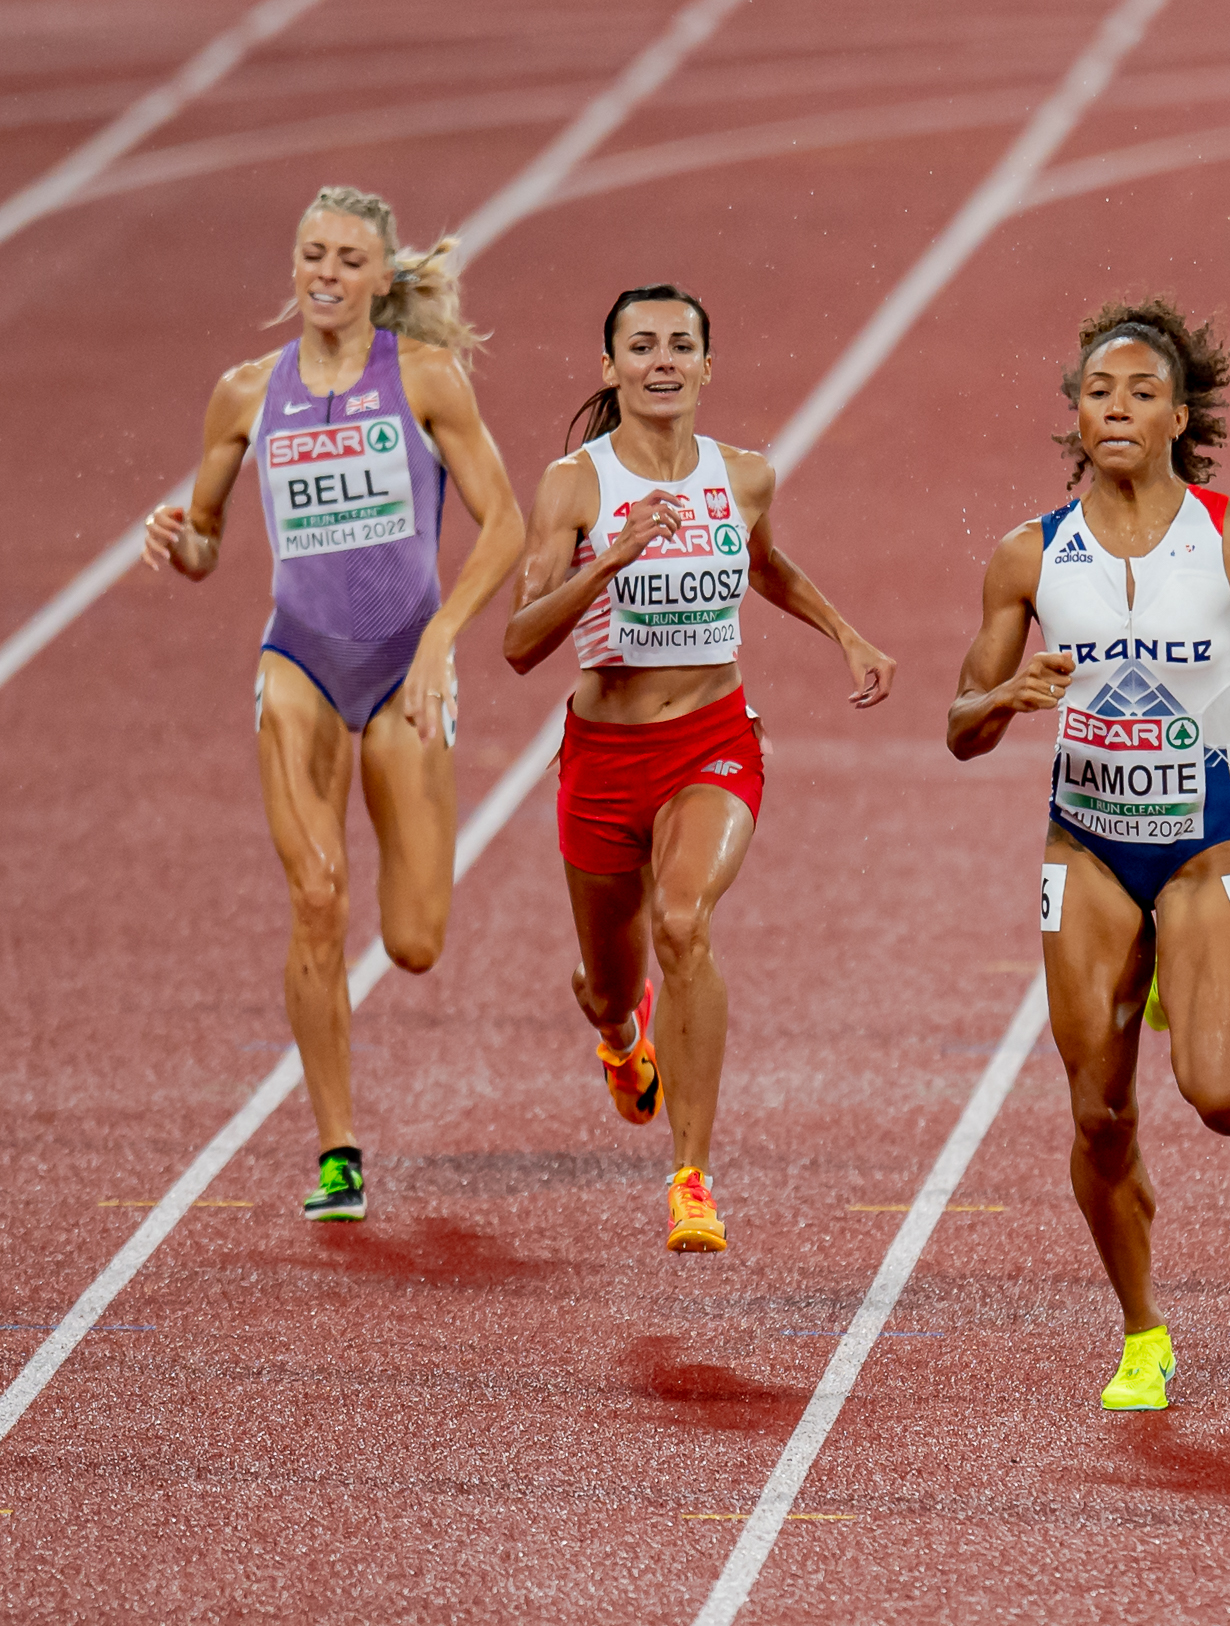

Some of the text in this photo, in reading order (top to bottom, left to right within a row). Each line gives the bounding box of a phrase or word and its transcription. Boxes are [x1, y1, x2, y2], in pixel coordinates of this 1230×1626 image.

[271, 430, 362, 464] SPAR
[288, 469, 389, 510] BELL
[310, 513, 336, 526] RUN
[286, 518, 406, 552] MUNICH 2022
[1054, 551, 1094, 564] adidas
[614, 568, 744, 606] WIELGOSZ
[652, 613, 679, 625] RUN
[682, 611, 717, 624] CLEAN
[618, 624, 735, 648] MUNICH 2022
[1066, 712, 1159, 747] SPAR
[1065, 752, 1198, 797] LAMOTE
[1096, 800, 1120, 814] RUN
[1123, 804, 1166, 816] CLEAN
[1147, 818, 1195, 838] 2022
